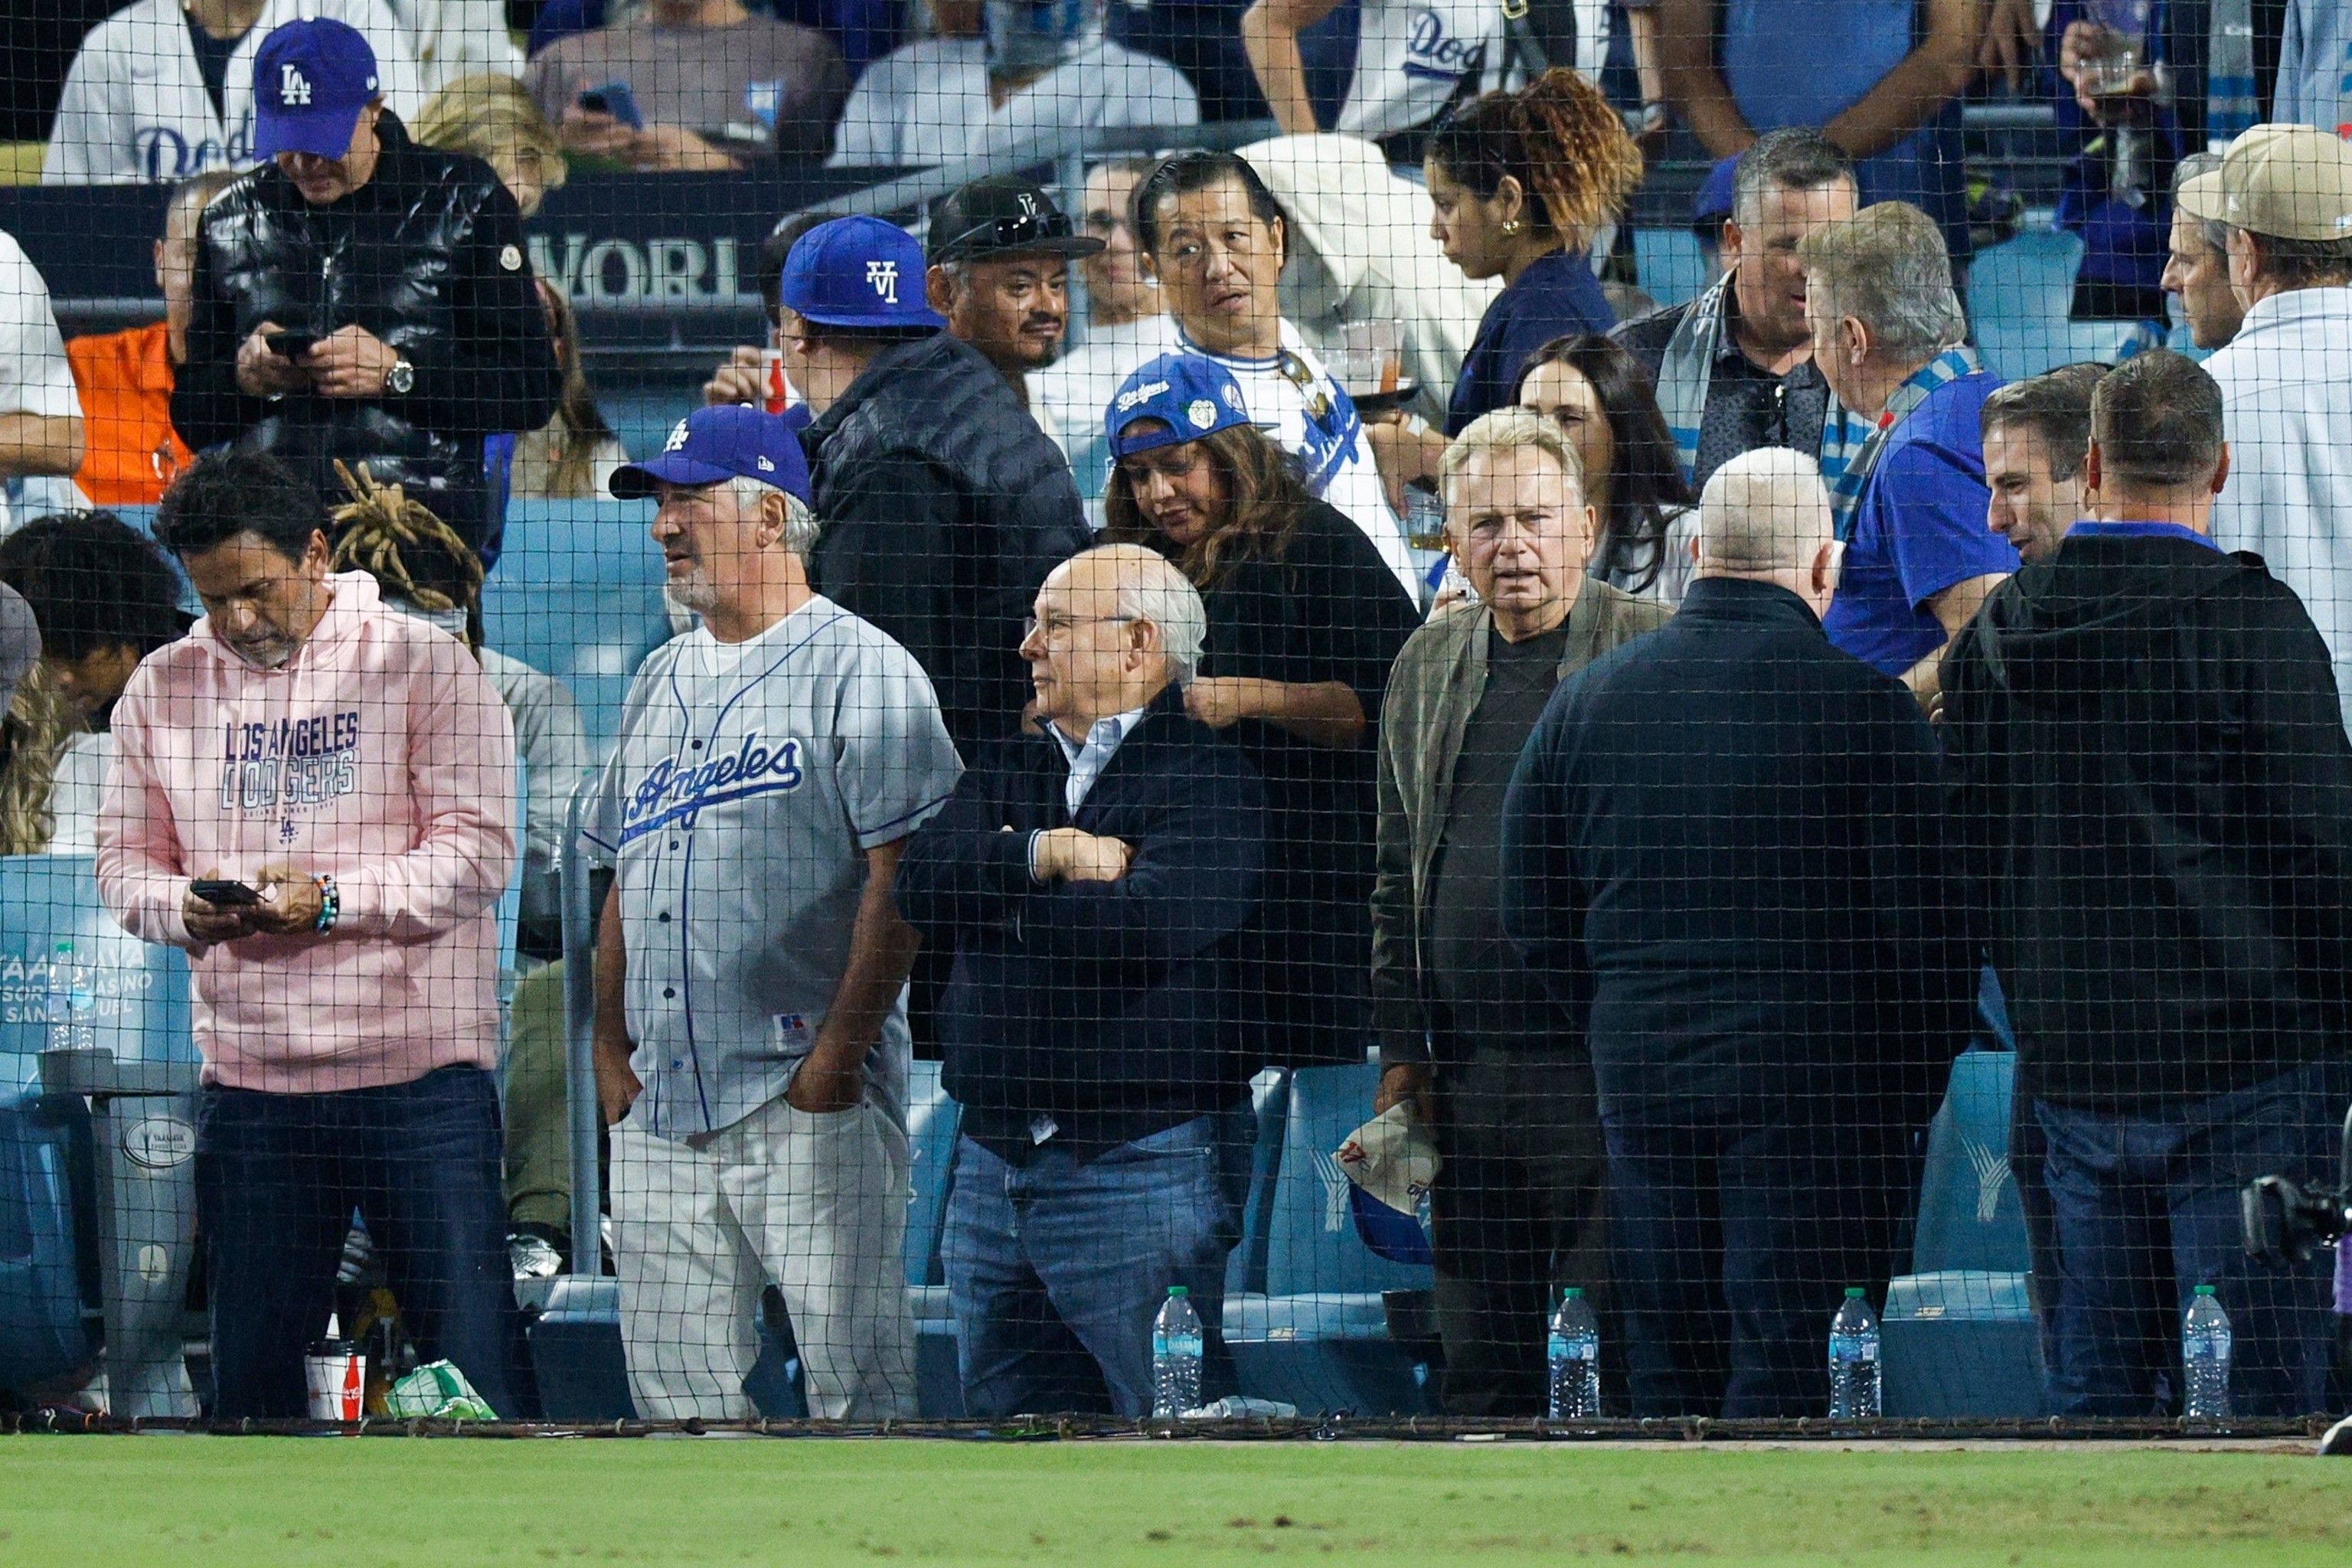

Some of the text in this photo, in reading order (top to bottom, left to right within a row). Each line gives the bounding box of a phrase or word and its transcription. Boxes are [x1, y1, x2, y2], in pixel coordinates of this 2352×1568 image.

[280, 64, 312, 105] LA
[526, 234, 744, 298] WORL
[225, 711, 359, 761] LOS ANGELES
[221, 748, 355, 810] DODGERS
[628, 730, 802, 831] Angeles
[279, 816, 296, 838] LA
[96, 972, 153, 995] ASINO
